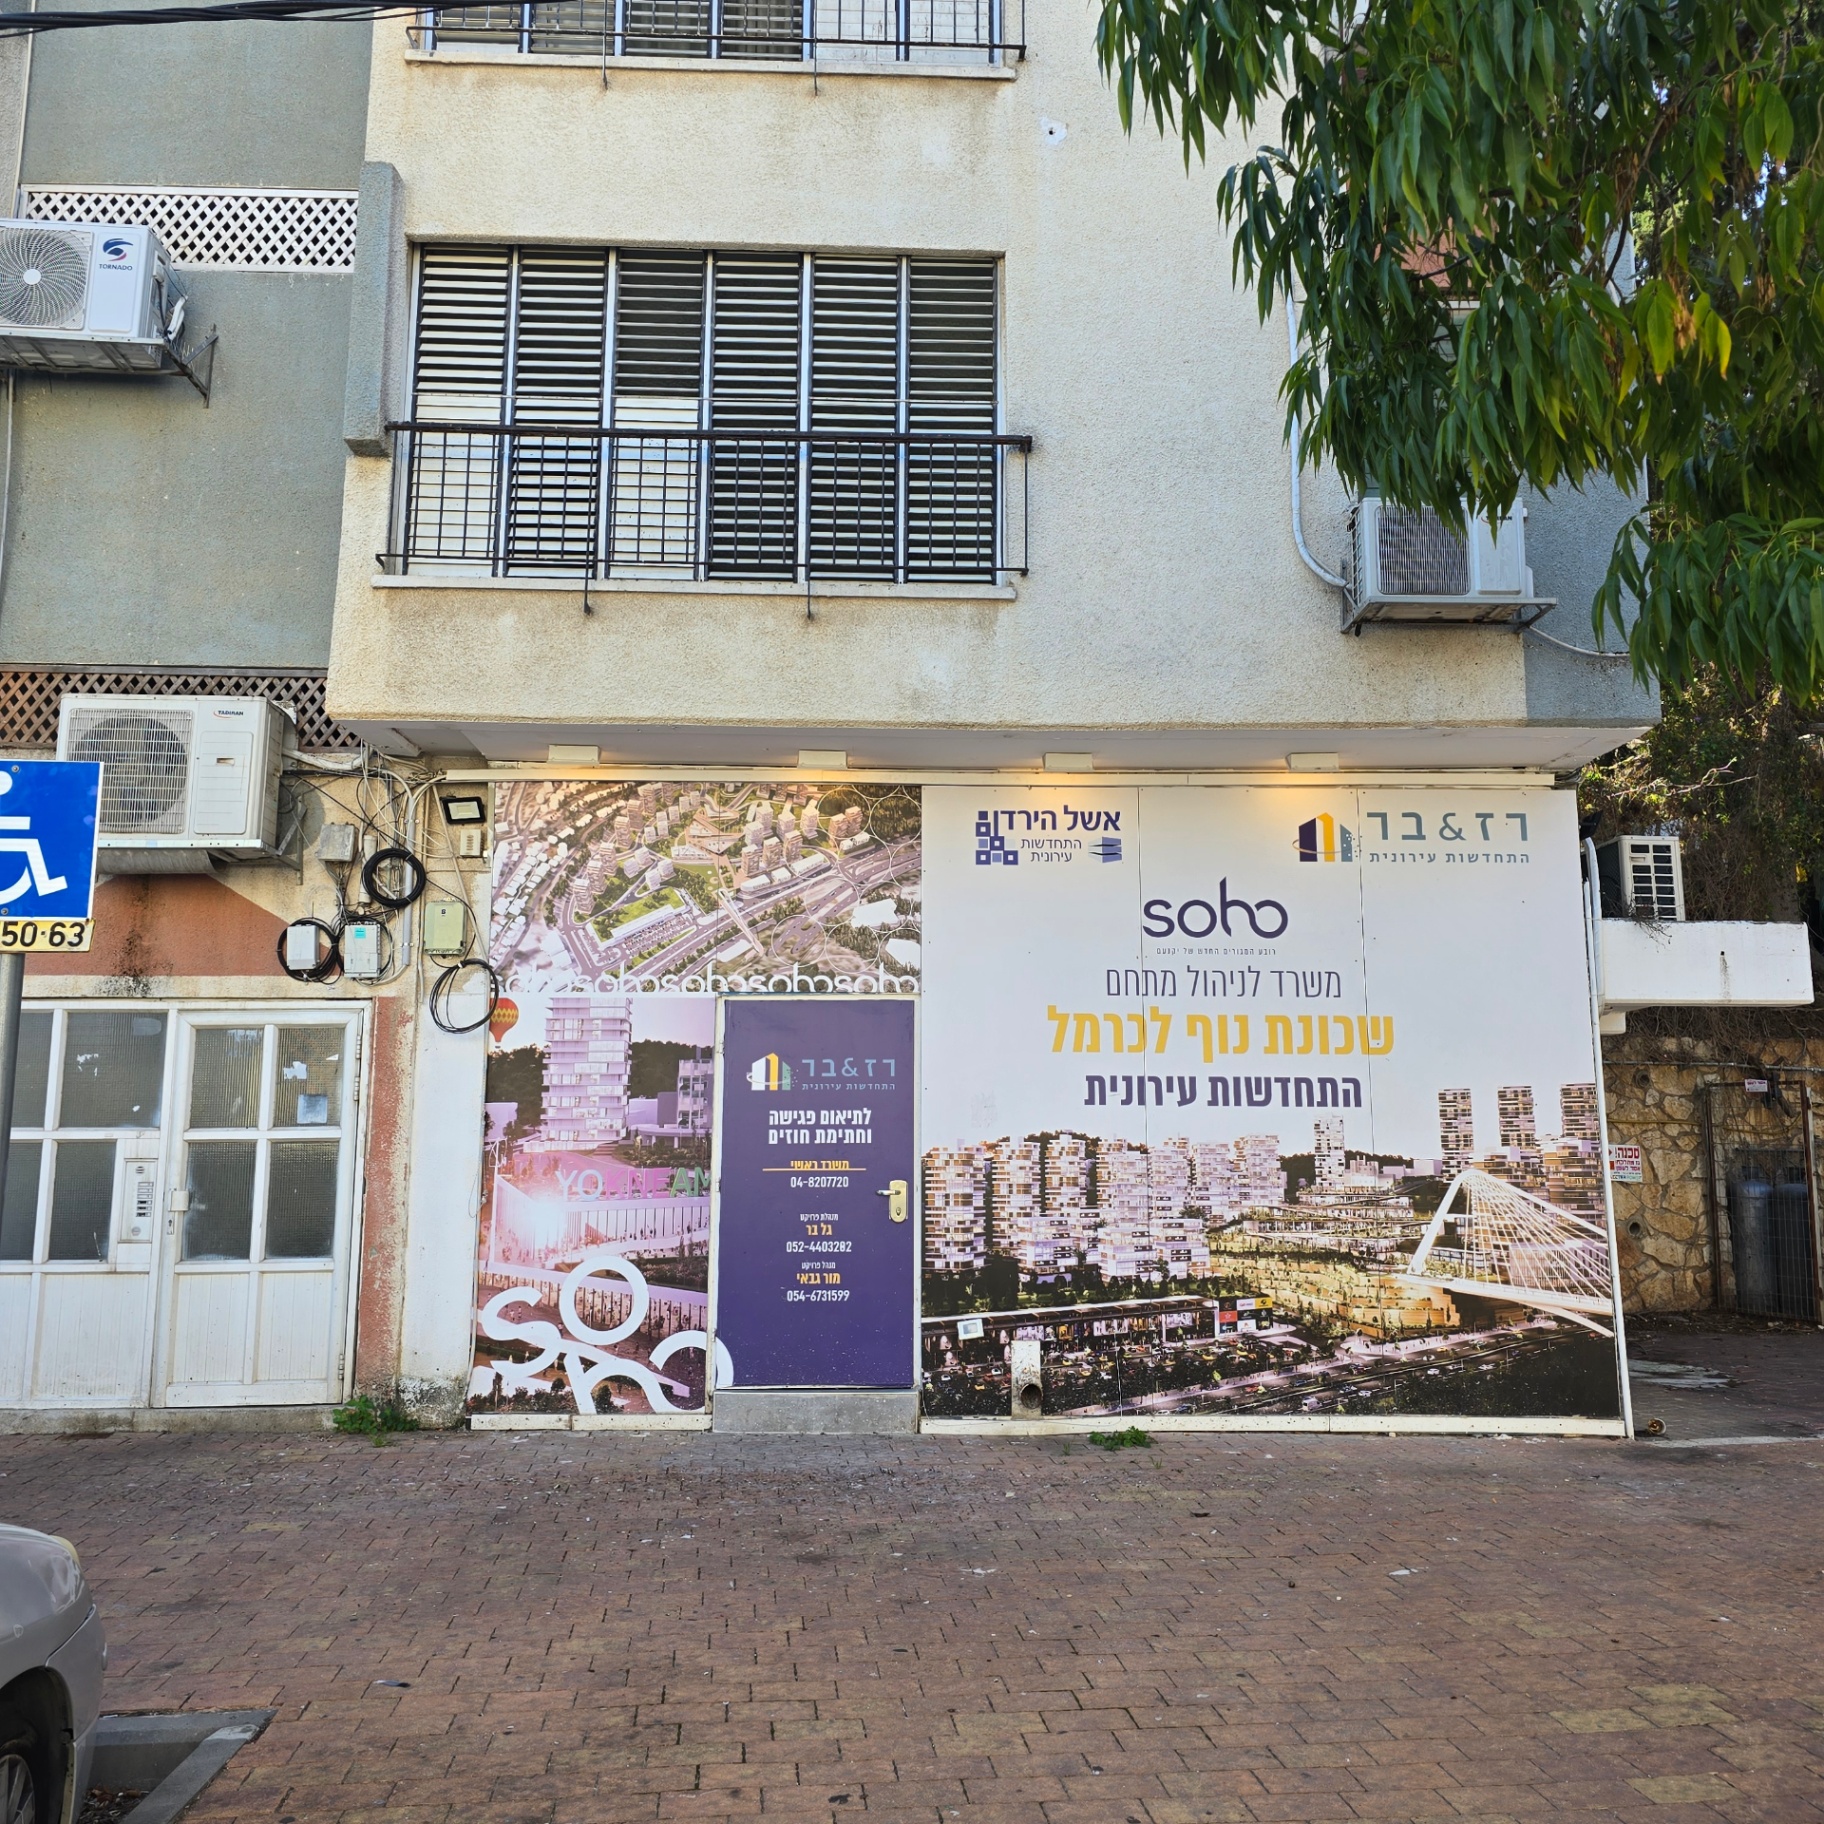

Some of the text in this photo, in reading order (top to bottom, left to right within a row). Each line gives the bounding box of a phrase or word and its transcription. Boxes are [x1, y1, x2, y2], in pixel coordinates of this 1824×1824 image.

[99, 263, 133, 271] TORNADO
[993, 804, 1121, 837] אשל הירדן
[1020, 838, 1082, 849] התחדשות
[1030, 851, 1072, 862] עירונית
[1369, 852, 1530, 863] התחדשות עירונית
[1142, 876, 1289, 939] soho
[1156, 947, 1180, 955] יקנעם
[1183, 947, 1194, 955] של
[1197, 947, 1219, 955] החדש
[1258, 948, 1276, 956] רובע
[1106, 965, 1341, 998] משרד לניהול מתחם
[1047, 1005, 1395, 1063] שכונת נוף לכרמל
[801, 1083, 896, 1091] התחדשות עירונית
[1083, 1074, 1362, 1108] התחדשות עירונית
[769, 1107, 872, 1126] לתיאום פגישה
[768, 1128, 872, 1145] וחתימת חוזים
[790, 1160, 850, 1170] משרד ראשי
[555, 1166, 711, 1201] YOKNEAM
[790, 1176, 849, 1188] 04-8207720
[800, 1213, 839, 1222] מנהלת פרויקט
[805, 1222, 833, 1236] גל בר
[786, 1241, 852, 1253] 052-4403282
[801, 1261, 836, 1270] מנהל פרויקט
[796, 1272, 841, 1285] מור גבאי
[786, 1290, 851, 1302] 054-6731599
